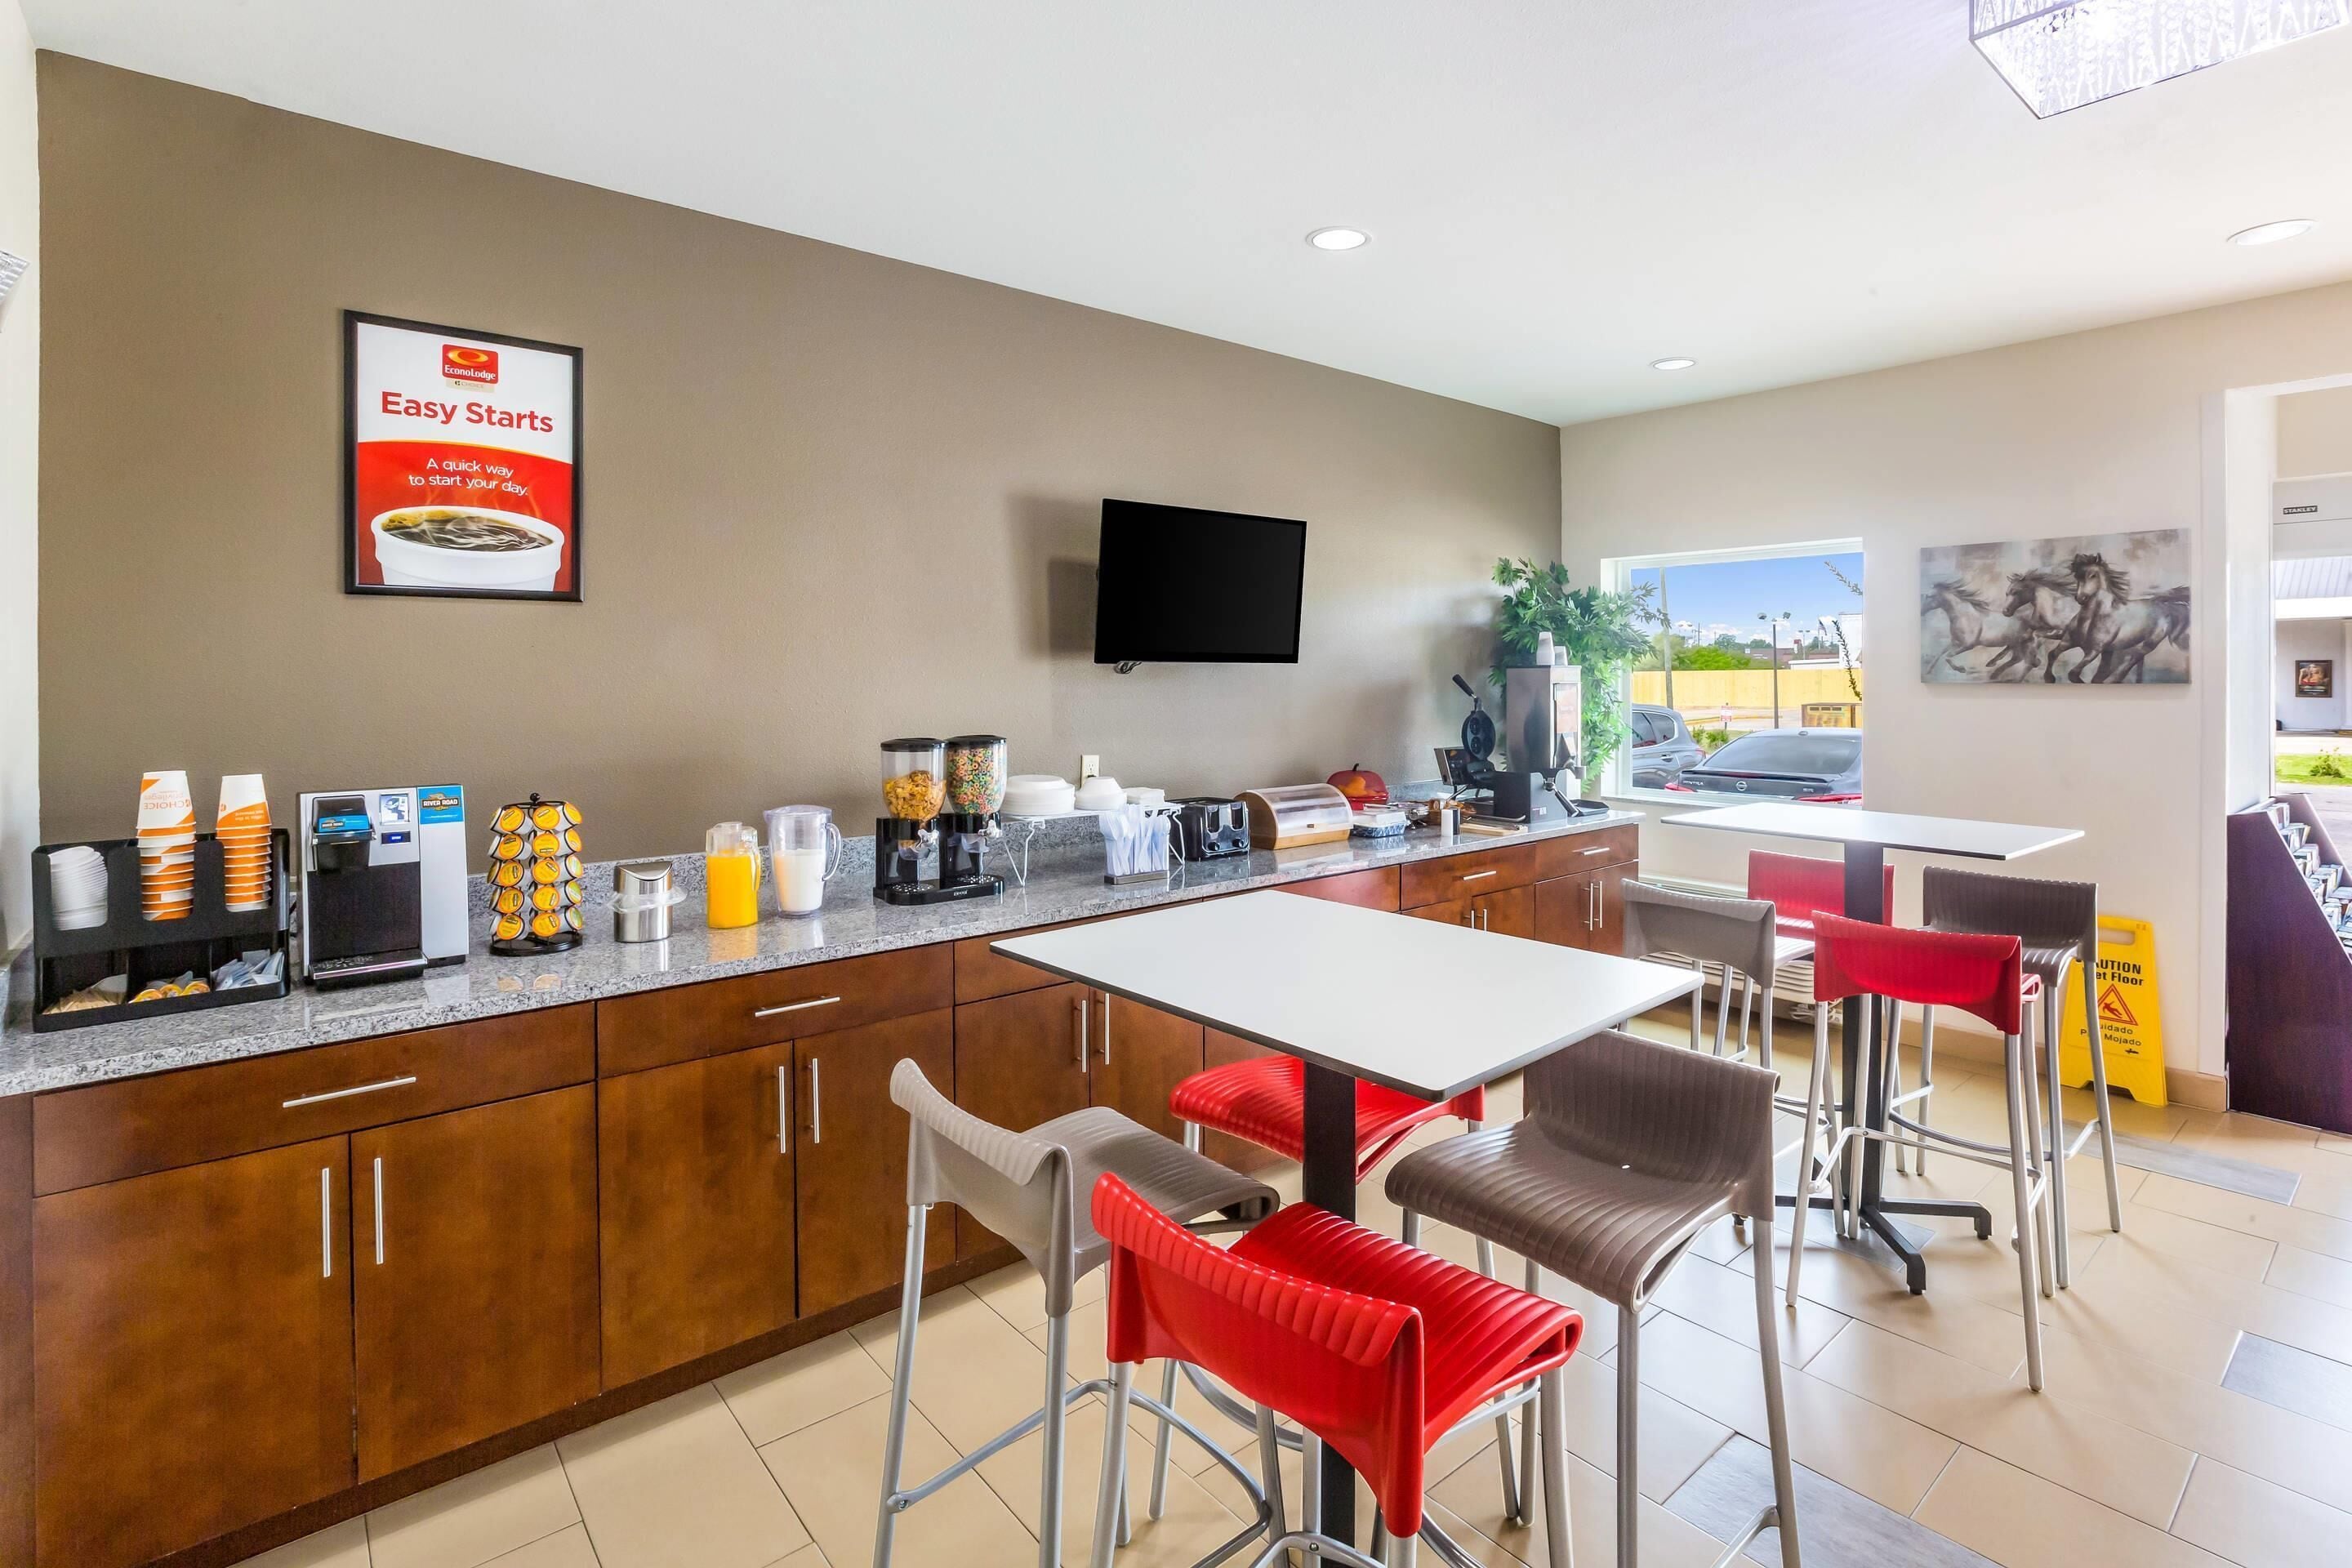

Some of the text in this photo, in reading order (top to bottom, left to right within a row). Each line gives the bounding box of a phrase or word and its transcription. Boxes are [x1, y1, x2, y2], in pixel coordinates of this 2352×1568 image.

[381, 391, 554, 433] Easy Starts
[426, 457, 514, 478] A quick way
[408, 474, 529, 496] to start your day.
[2096, 959, 2141, 974] UTION
[2111, 972, 2144, 986] Floor
[2104, 1033, 2141, 1046] Mojado
